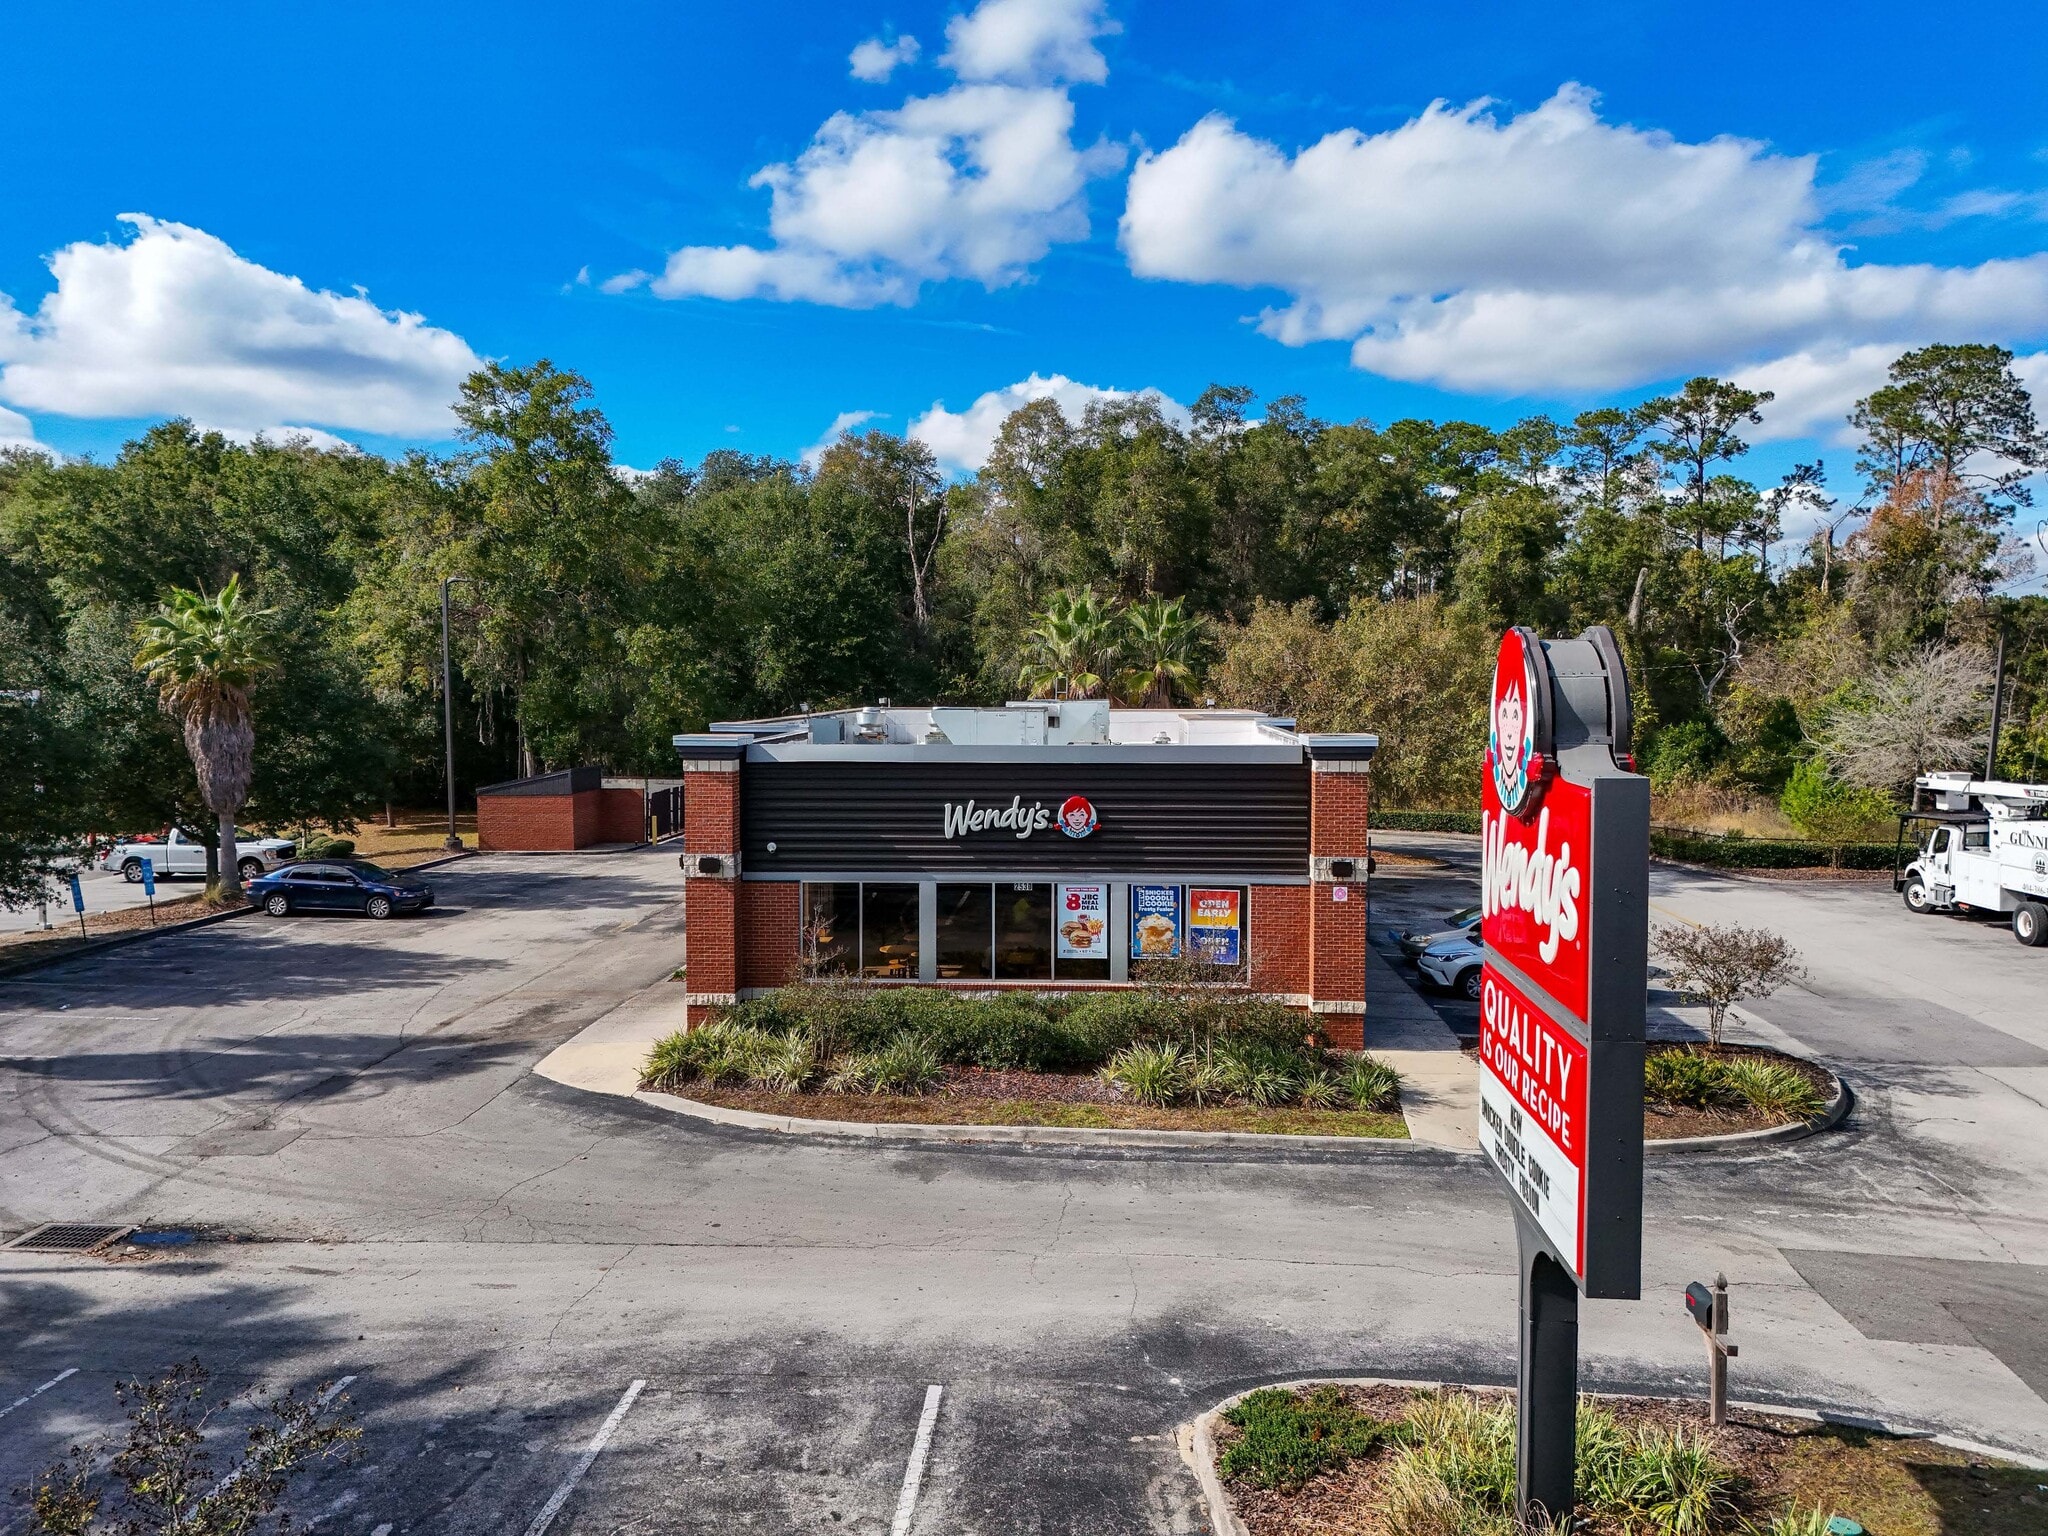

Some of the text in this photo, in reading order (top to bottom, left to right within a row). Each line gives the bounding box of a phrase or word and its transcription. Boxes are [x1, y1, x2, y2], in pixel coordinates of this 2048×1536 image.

[944, 795, 1050, 839] Wendy's
[1199, 900, 1229, 908] OPEN
[1482, 806, 1580, 964] Wendy's
[1197, 909, 1231, 918] EARLY
[1484, 979, 1573, 1101] QUALITY
[1483, 1027, 1571, 1149] IS OUR RECIPE
[1511, 1103, 1522, 1136] NEW
